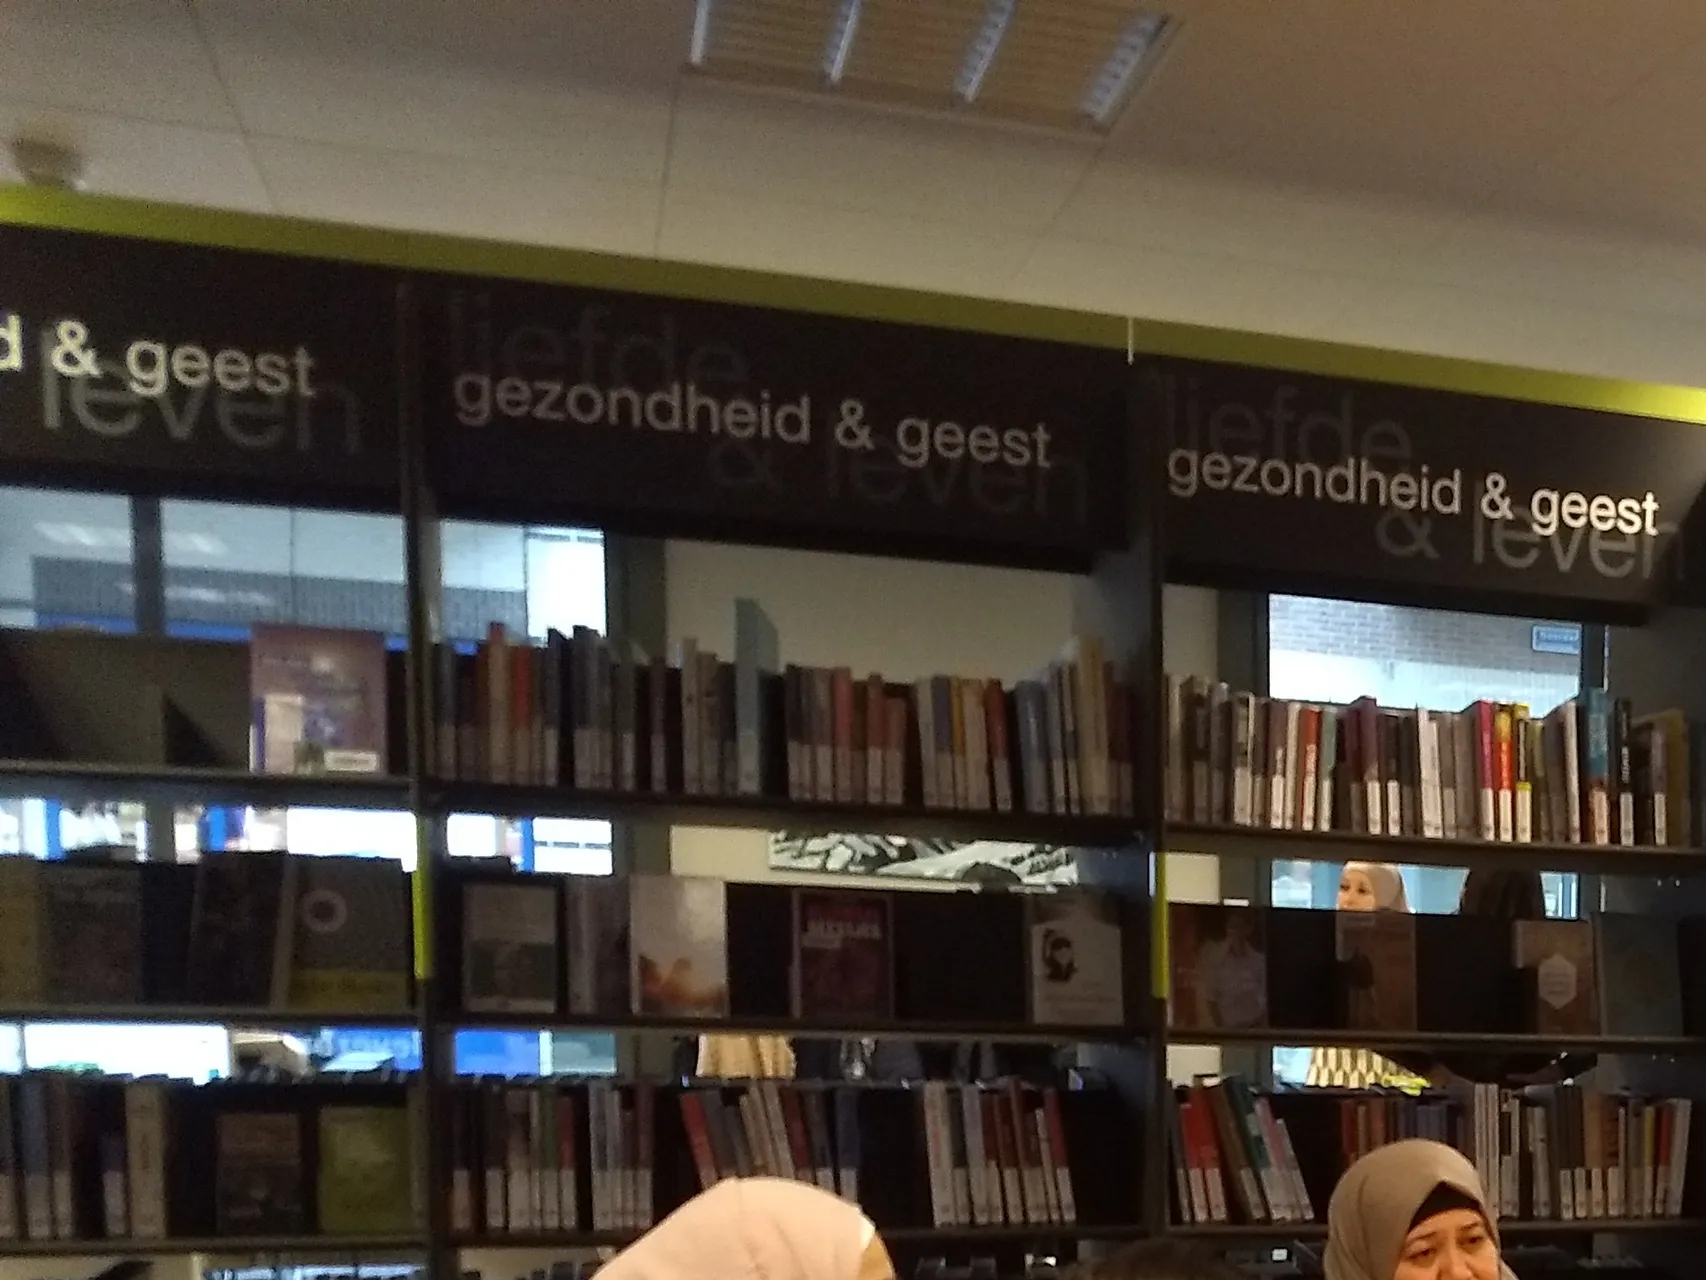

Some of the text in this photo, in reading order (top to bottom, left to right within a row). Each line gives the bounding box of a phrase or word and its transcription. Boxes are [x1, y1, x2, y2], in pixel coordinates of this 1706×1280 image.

[52, 320, 104, 377] &
[127, 338, 320, 398] geest
[449, 291, 749, 392] liefde
[42, 330, 362, 453] leven
[453, 374, 1052, 469] gezondheid & geest
[1166, 373, 1412, 470] liefde
[1168, 449, 1660, 536] gezondheid & geest
[1473, 480, 1684, 580] leven
